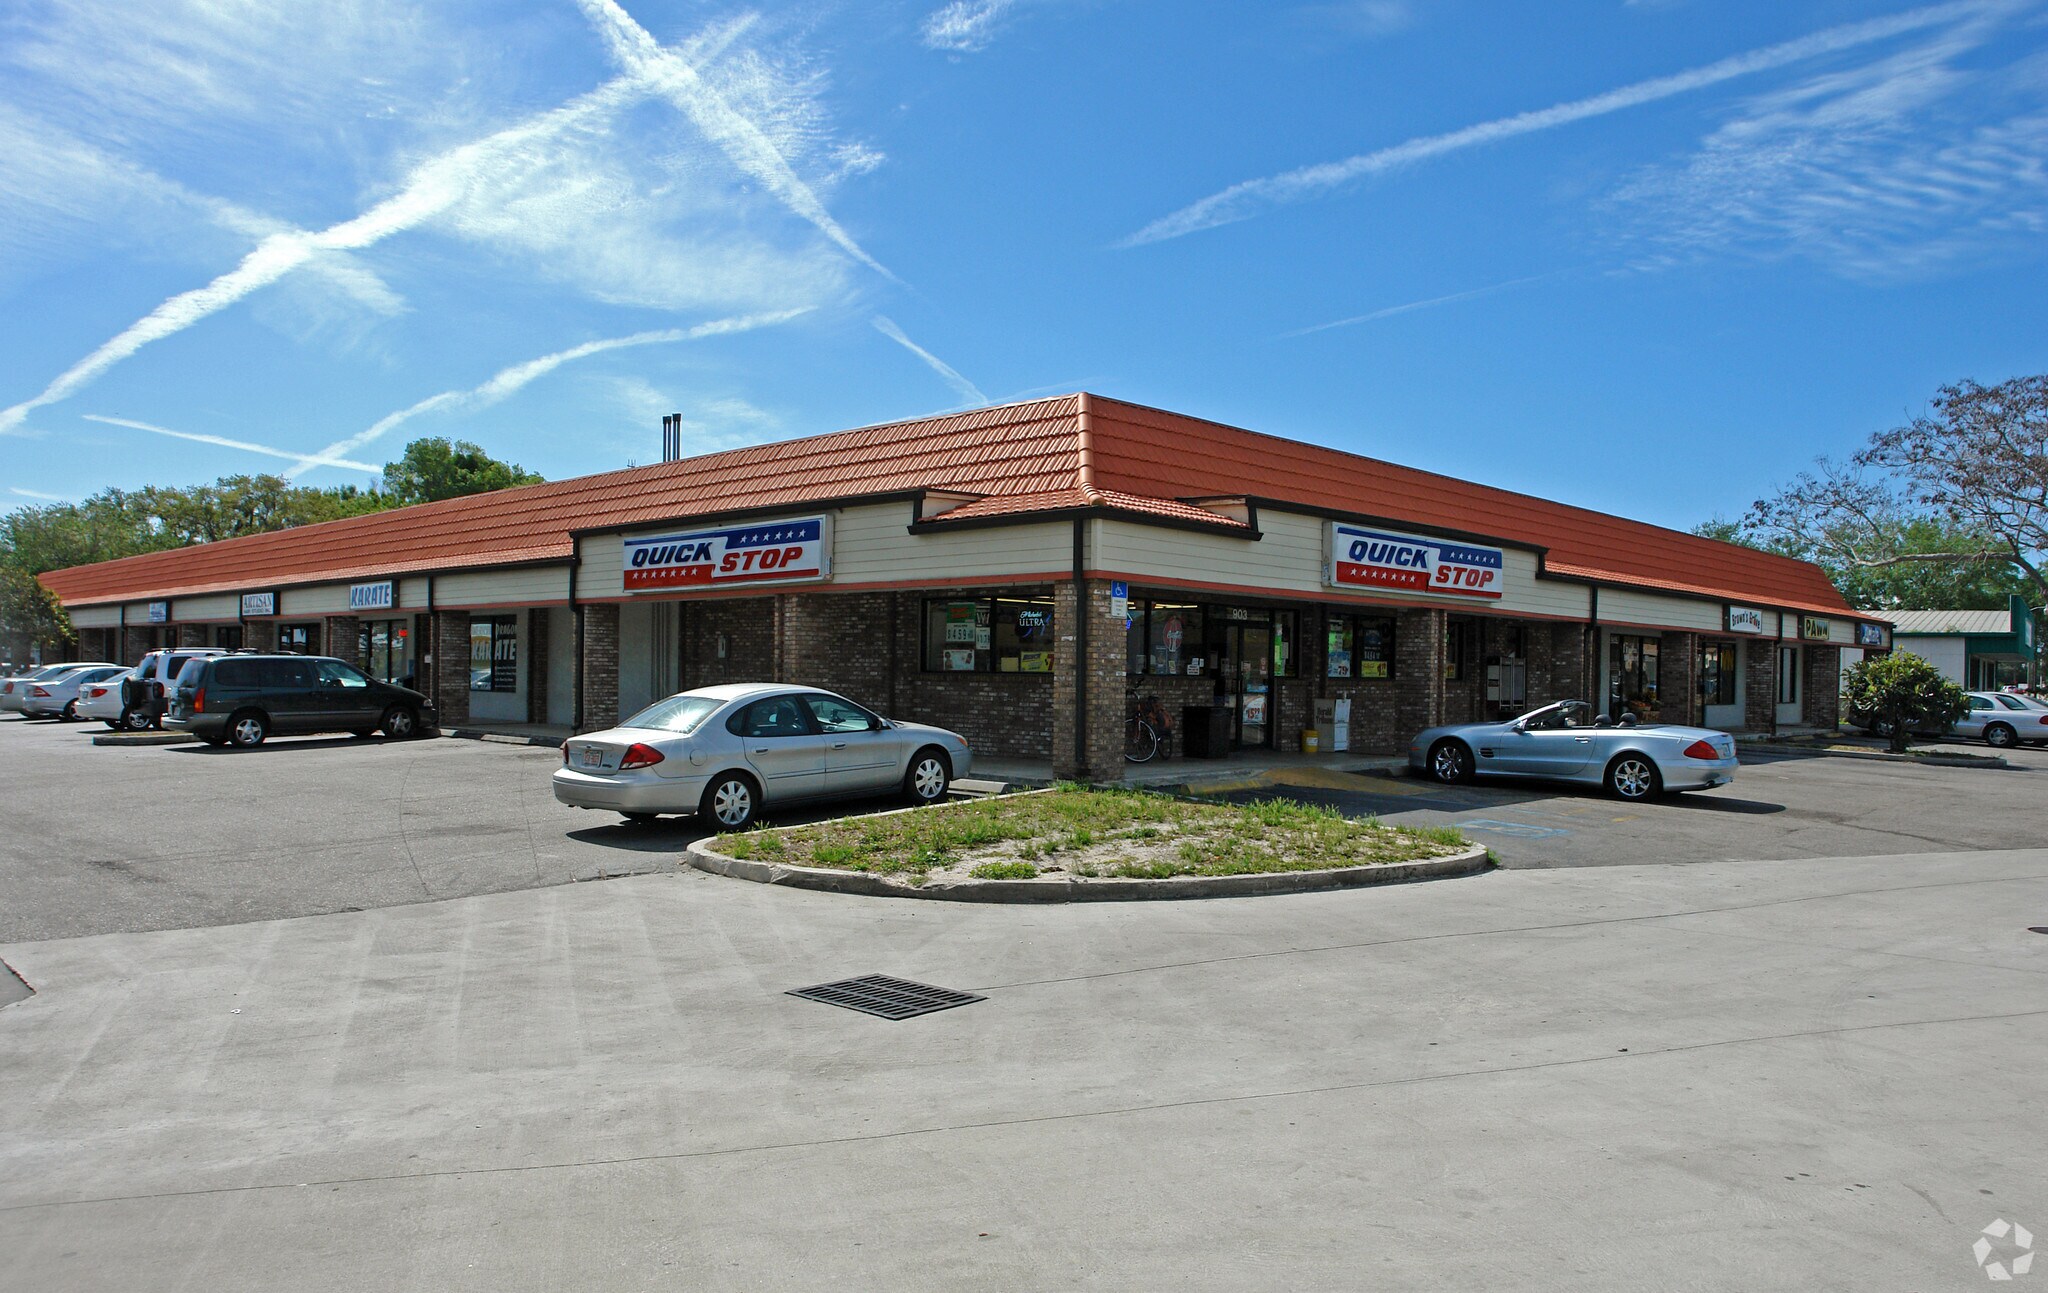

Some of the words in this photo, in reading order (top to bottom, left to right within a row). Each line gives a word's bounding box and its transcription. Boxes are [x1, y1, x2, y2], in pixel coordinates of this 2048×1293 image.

[631, 541, 713, 568] QUICK
[719, 546, 803, 572] STOP
[1348, 539, 1428, 569] QUICK
[1435, 565, 1494, 588] STOP
[244, 594, 272, 608] ARTISAN
[351, 583, 390, 607] KARATE
[1019, 618, 1045, 626] ULTRA
[1232, 608, 1248, 620] 903
[1806, 619, 1828, 637] PAWN
